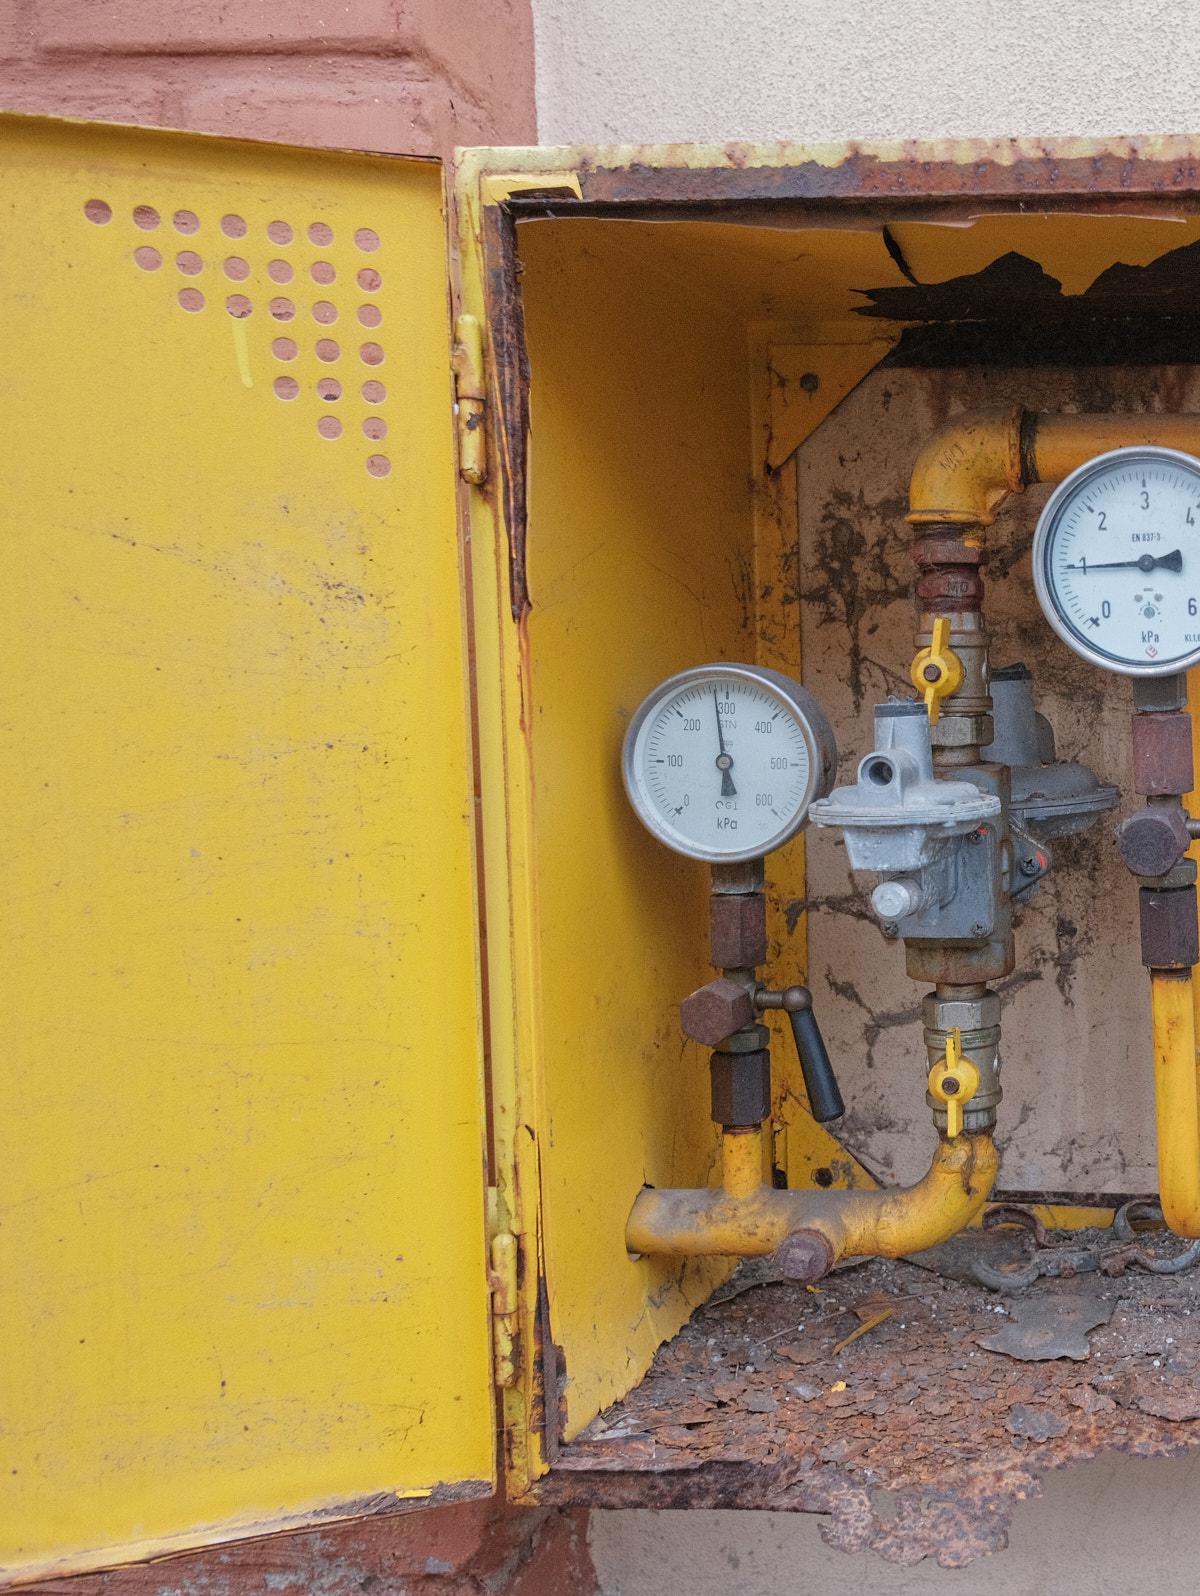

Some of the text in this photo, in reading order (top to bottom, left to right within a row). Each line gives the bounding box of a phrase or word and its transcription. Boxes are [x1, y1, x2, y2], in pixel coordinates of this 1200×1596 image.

[1140, 491, 1150, 510] 3
[1098, 512, 1107, 531] 2
[1186, 507, 1195, 526] 4
[1080, 557, 1087, 575] 1
[1102, 600, 1111, 618] 0
[1188, 598, 1197, 616] 6
[1142, 631, 1159, 643] kPa
[718, 702, 736, 715] 300
[683, 718, 701, 731] 200
[754, 721, 772, 734] 400
[667, 755, 683, 767] 100
[770, 758, 787, 770] 500
[684, 794, 690, 806] 0
[756, 793, 772, 806] 600
[717, 817, 738, 830] kPa
